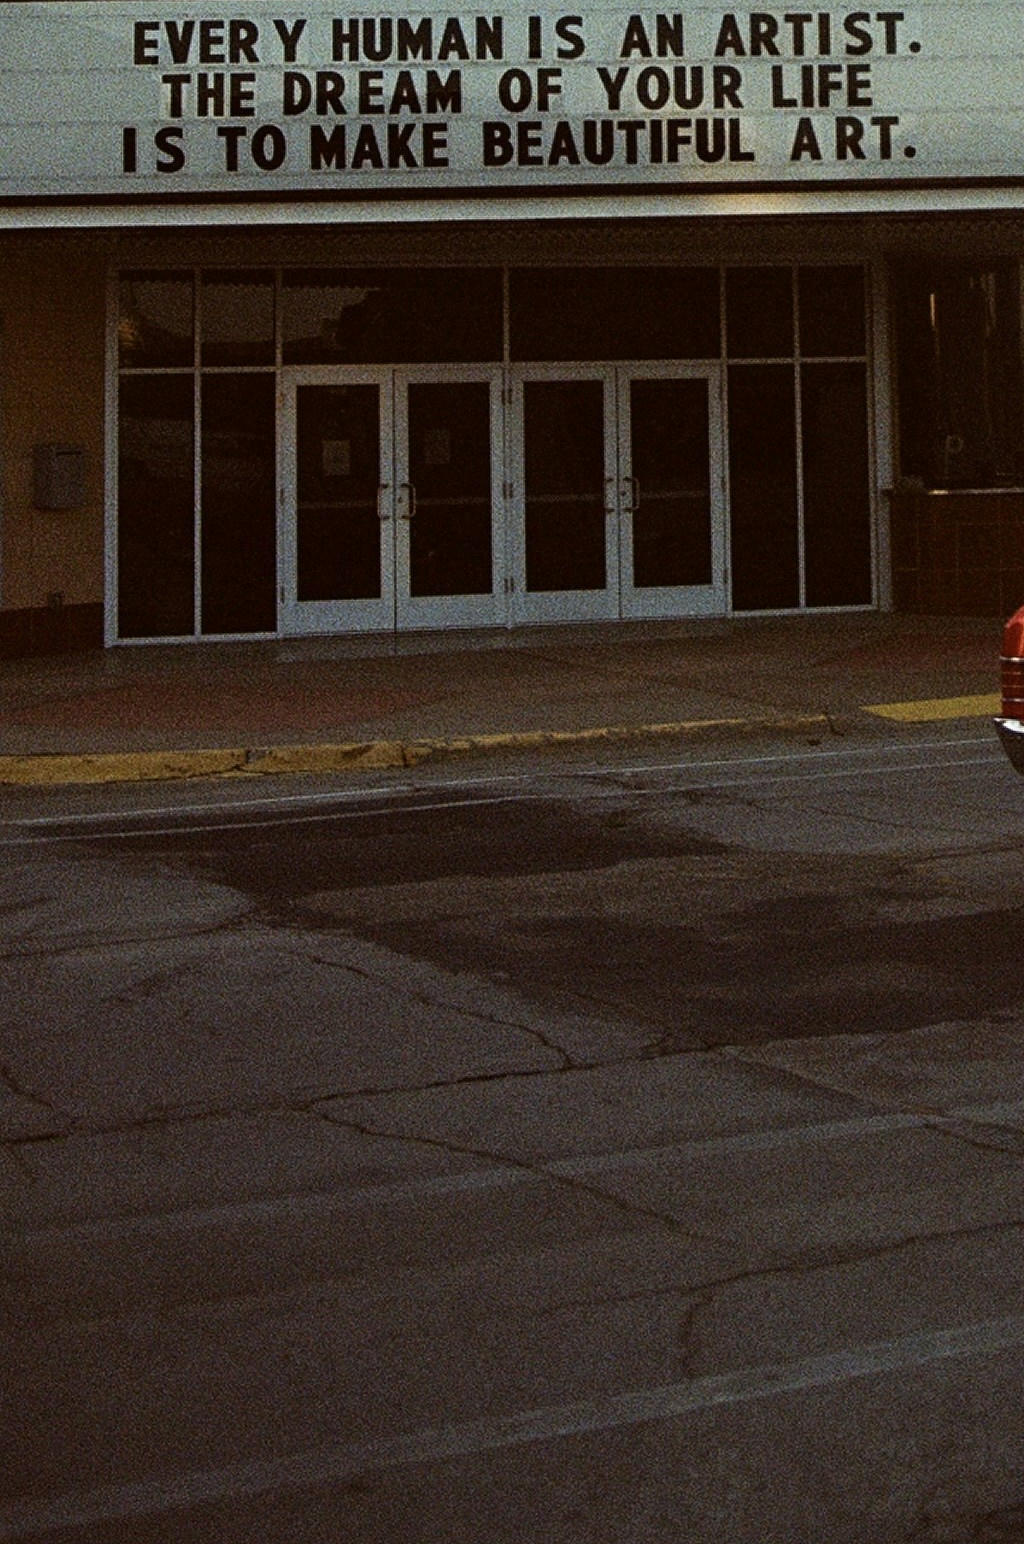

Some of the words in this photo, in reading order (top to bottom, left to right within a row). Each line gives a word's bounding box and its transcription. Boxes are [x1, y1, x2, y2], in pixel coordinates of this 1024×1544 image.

[134, 18, 306, 66] EVERY
[332, 16, 503, 62] HUMAN
[528, 15, 585, 60] IS
[620, 13, 684, 58] AN
[714, 11, 922, 57] ARTIST.
[163, 72, 256, 118] THE
[283, 69, 462, 116] DREAM
[498, 67, 563, 112] OF
[596, 64, 743, 111] YOUR
[771, 63, 873, 108] LIFE
[122, 126, 186, 174] IS
[217, 125, 286, 172] TO
[310, 122, 450, 171] MAKE
[483, 117, 755, 167] BEAUTIFUL
[789, 115, 917, 161] ART.
